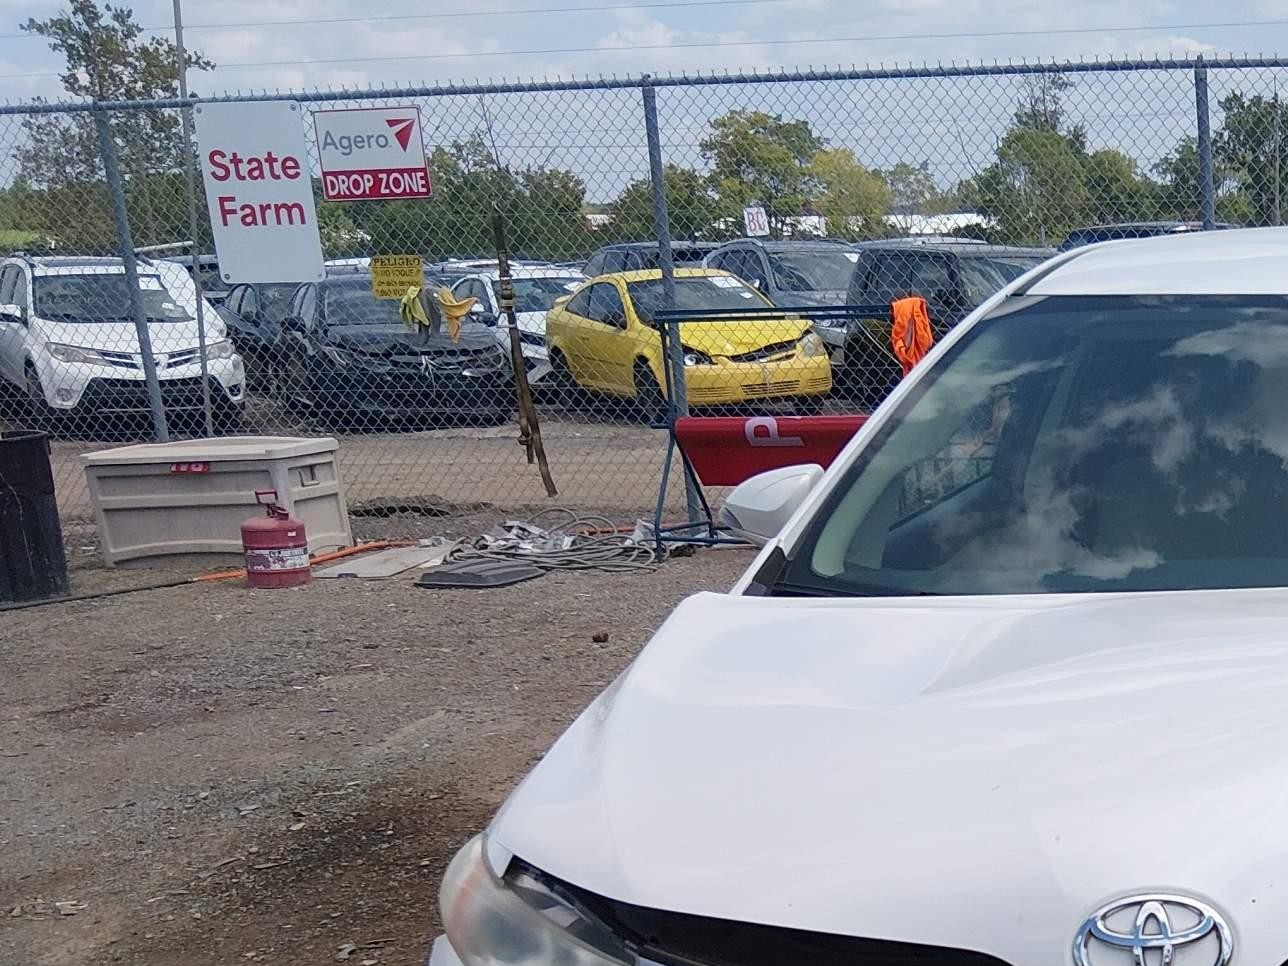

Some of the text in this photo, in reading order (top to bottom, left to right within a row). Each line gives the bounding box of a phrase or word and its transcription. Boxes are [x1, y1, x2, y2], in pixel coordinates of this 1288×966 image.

[322, 130, 389, 155] Agero
[208, 150, 301, 181] State
[326, 172, 428, 196] DROP ZONE
[218, 196, 307, 227] Farm
